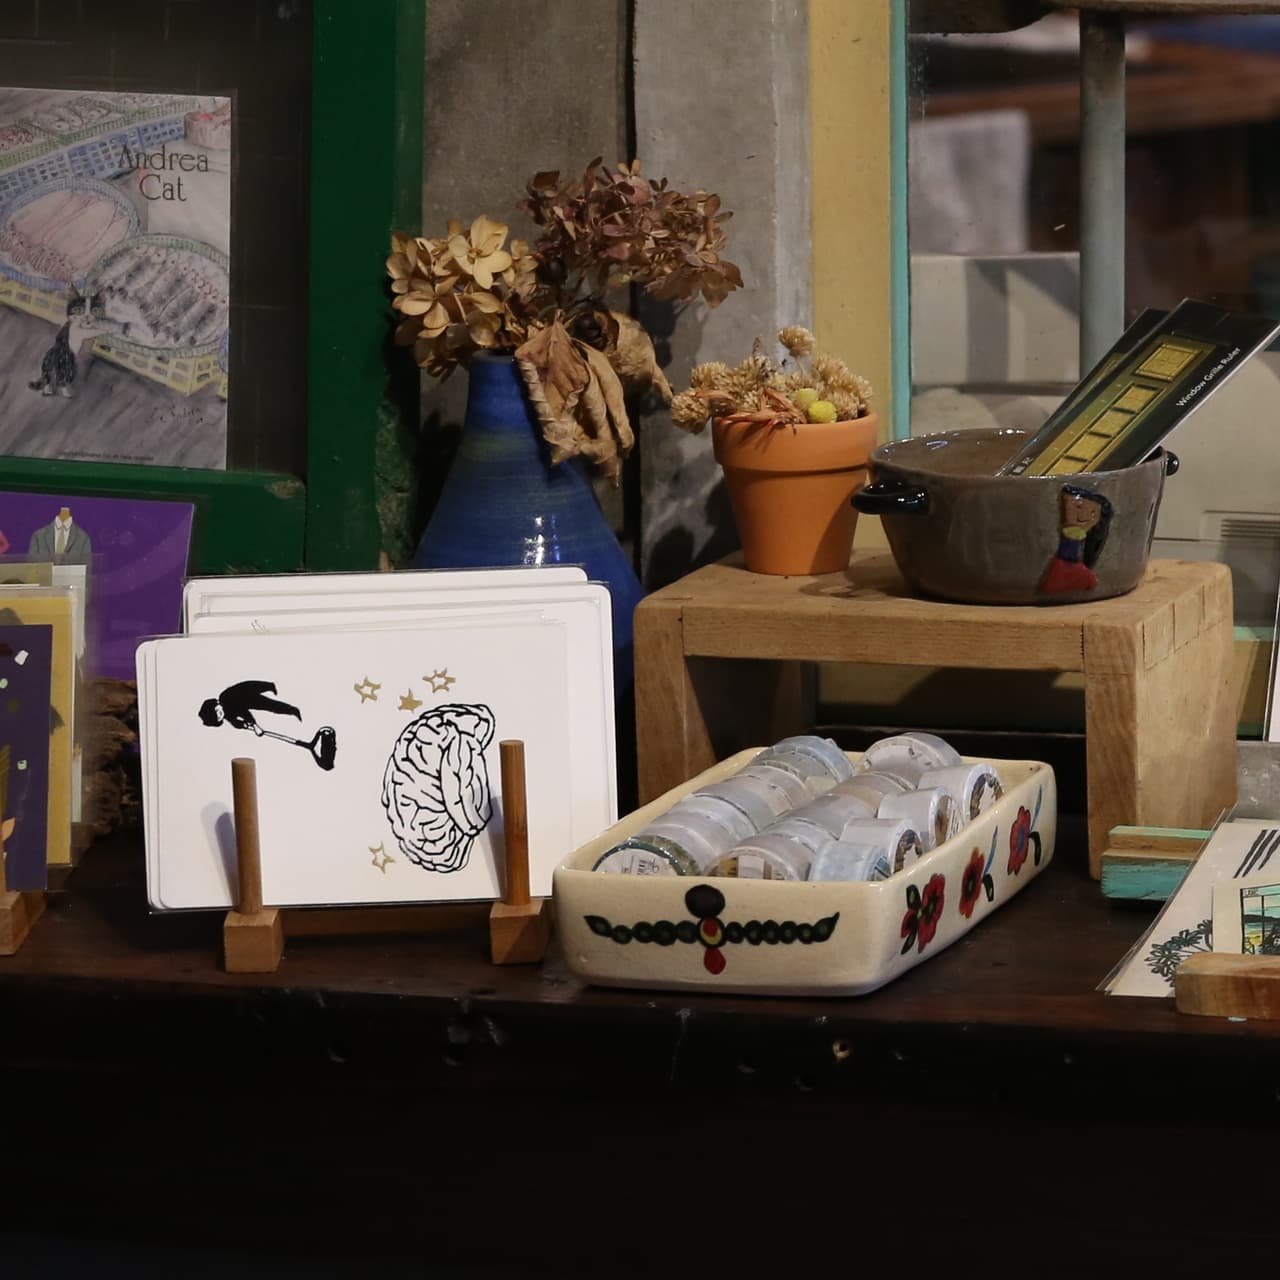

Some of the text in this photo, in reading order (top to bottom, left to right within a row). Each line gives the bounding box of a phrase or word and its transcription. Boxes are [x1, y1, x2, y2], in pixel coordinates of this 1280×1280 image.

[118, 144, 209, 172] Andrea
[139, 174, 187, 202] Cat
[1176, 347, 1241, 406] Window Grille Ruler
